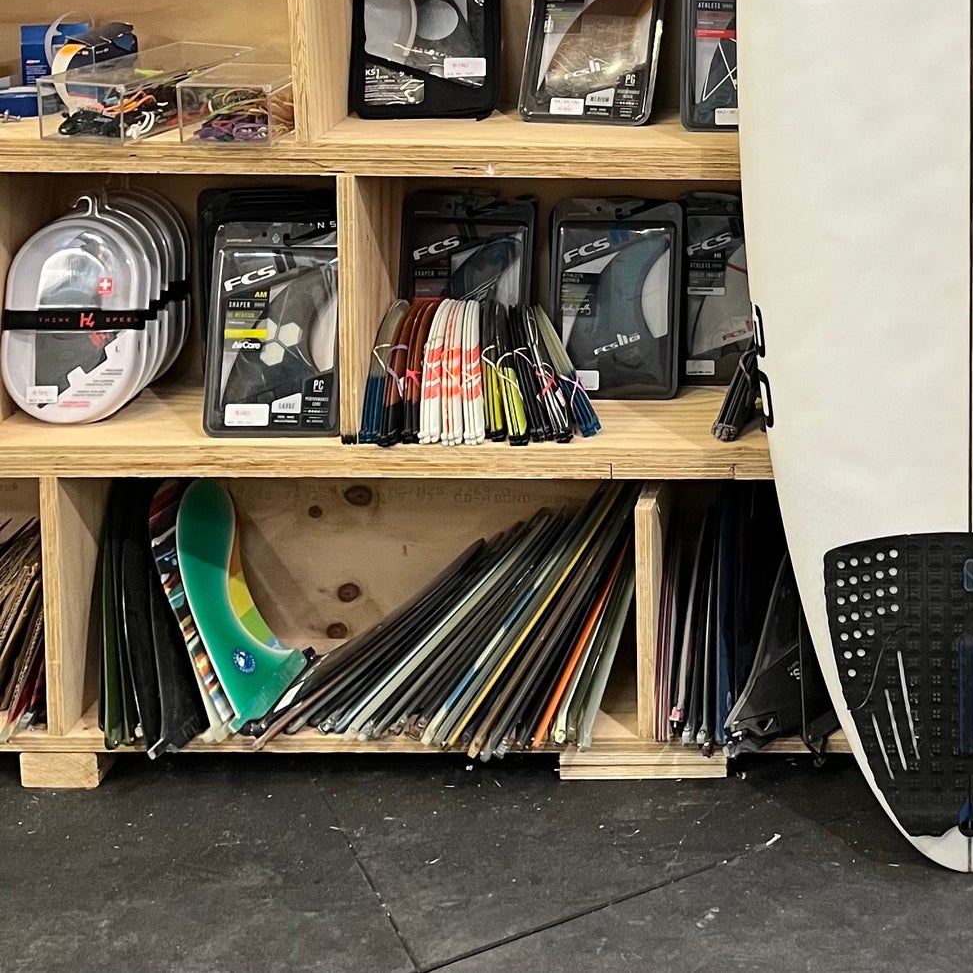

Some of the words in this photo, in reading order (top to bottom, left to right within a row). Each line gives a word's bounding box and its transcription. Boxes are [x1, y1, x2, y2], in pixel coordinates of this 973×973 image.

[697, 0, 721, 9] ATHLETE
[625, 74, 636, 85] PG
[412, 236, 460, 261] FCS
[563, 237, 611, 264] FCS
[687, 232, 732, 256] FCS
[223, 265, 277, 292] FCS
[231, 340, 261, 349] AirCore
[313, 379, 325, 391] PC
